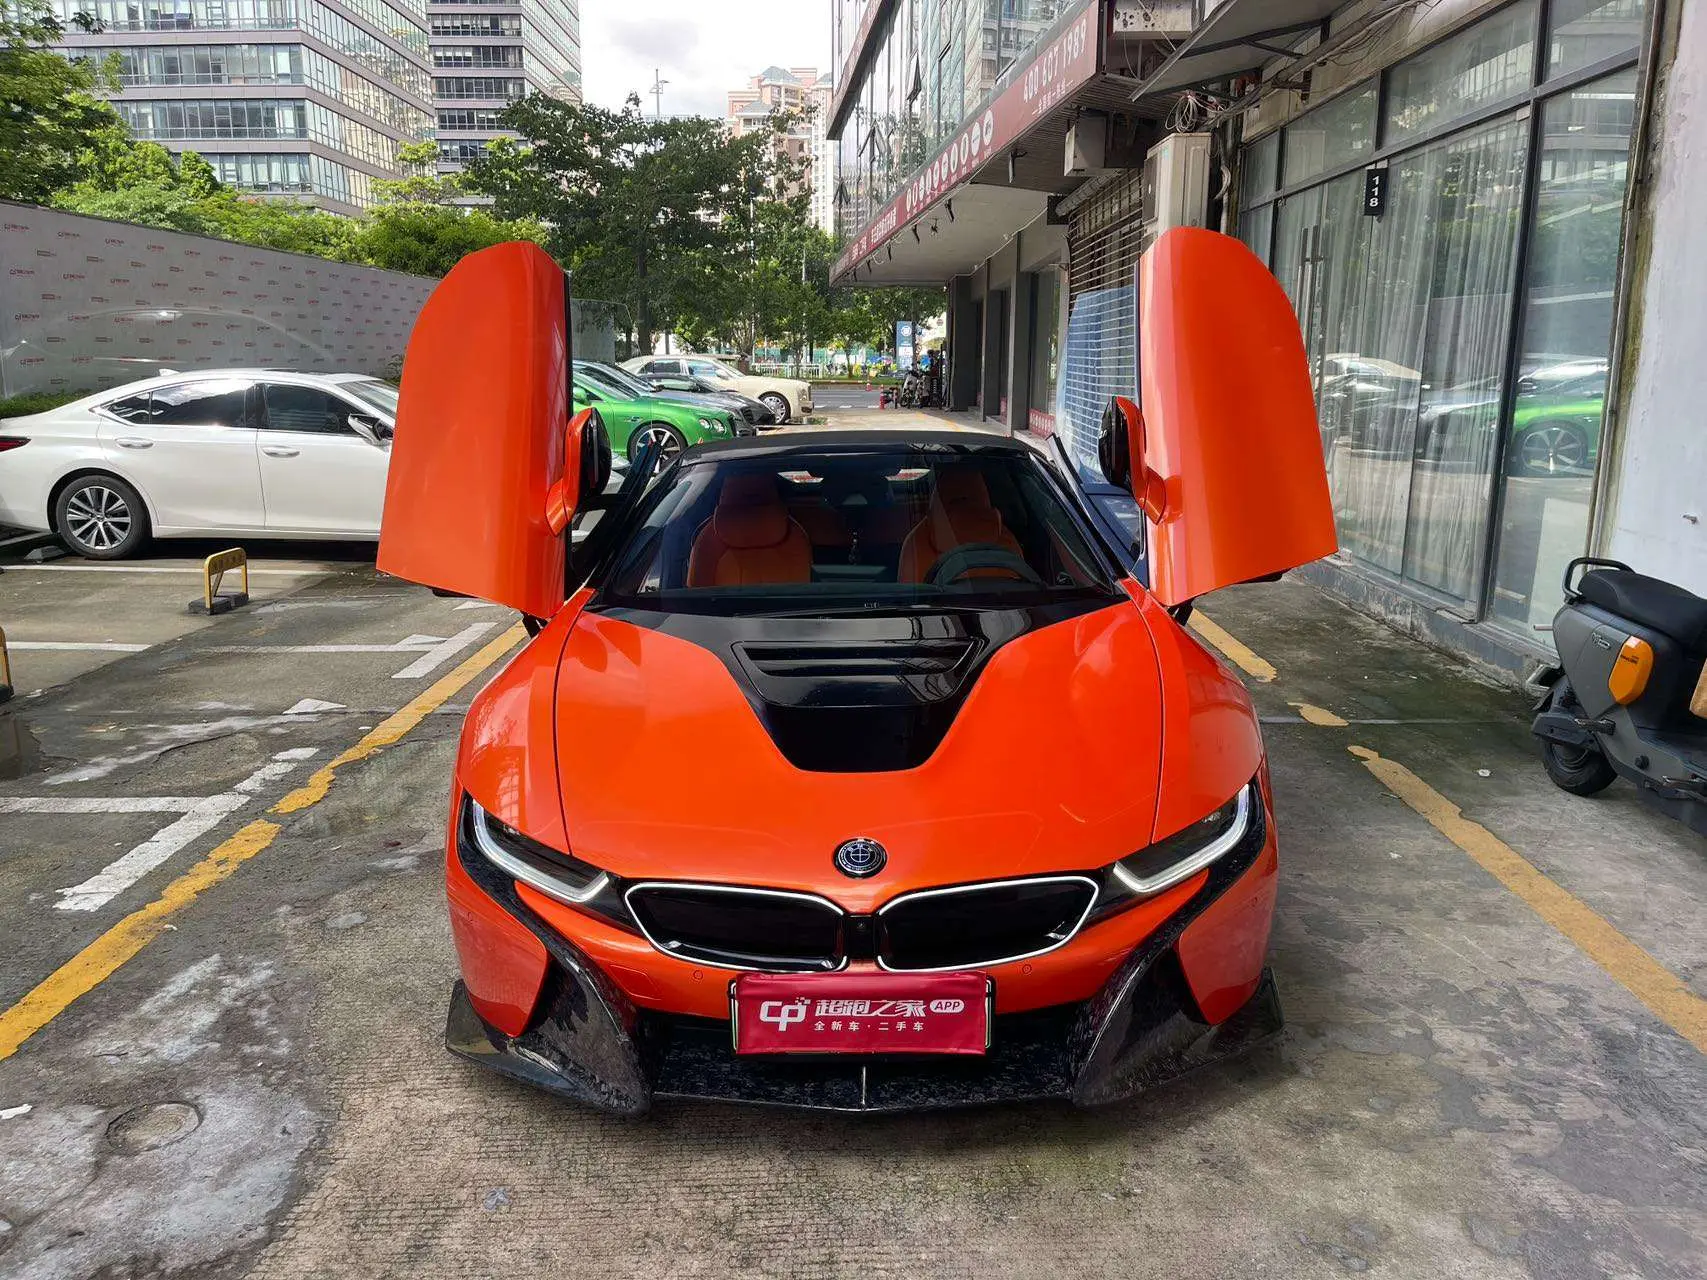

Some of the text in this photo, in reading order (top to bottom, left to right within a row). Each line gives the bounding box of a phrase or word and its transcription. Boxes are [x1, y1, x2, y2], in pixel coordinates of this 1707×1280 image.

[1023, 65, 1039, 103] 400
[1042, 45, 1060, 86] 607
[1063, 18, 1087, 69] 1989
[1369, 175, 1380, 207] 118
[814, 999, 961, 1017] 超跑之家 APP
